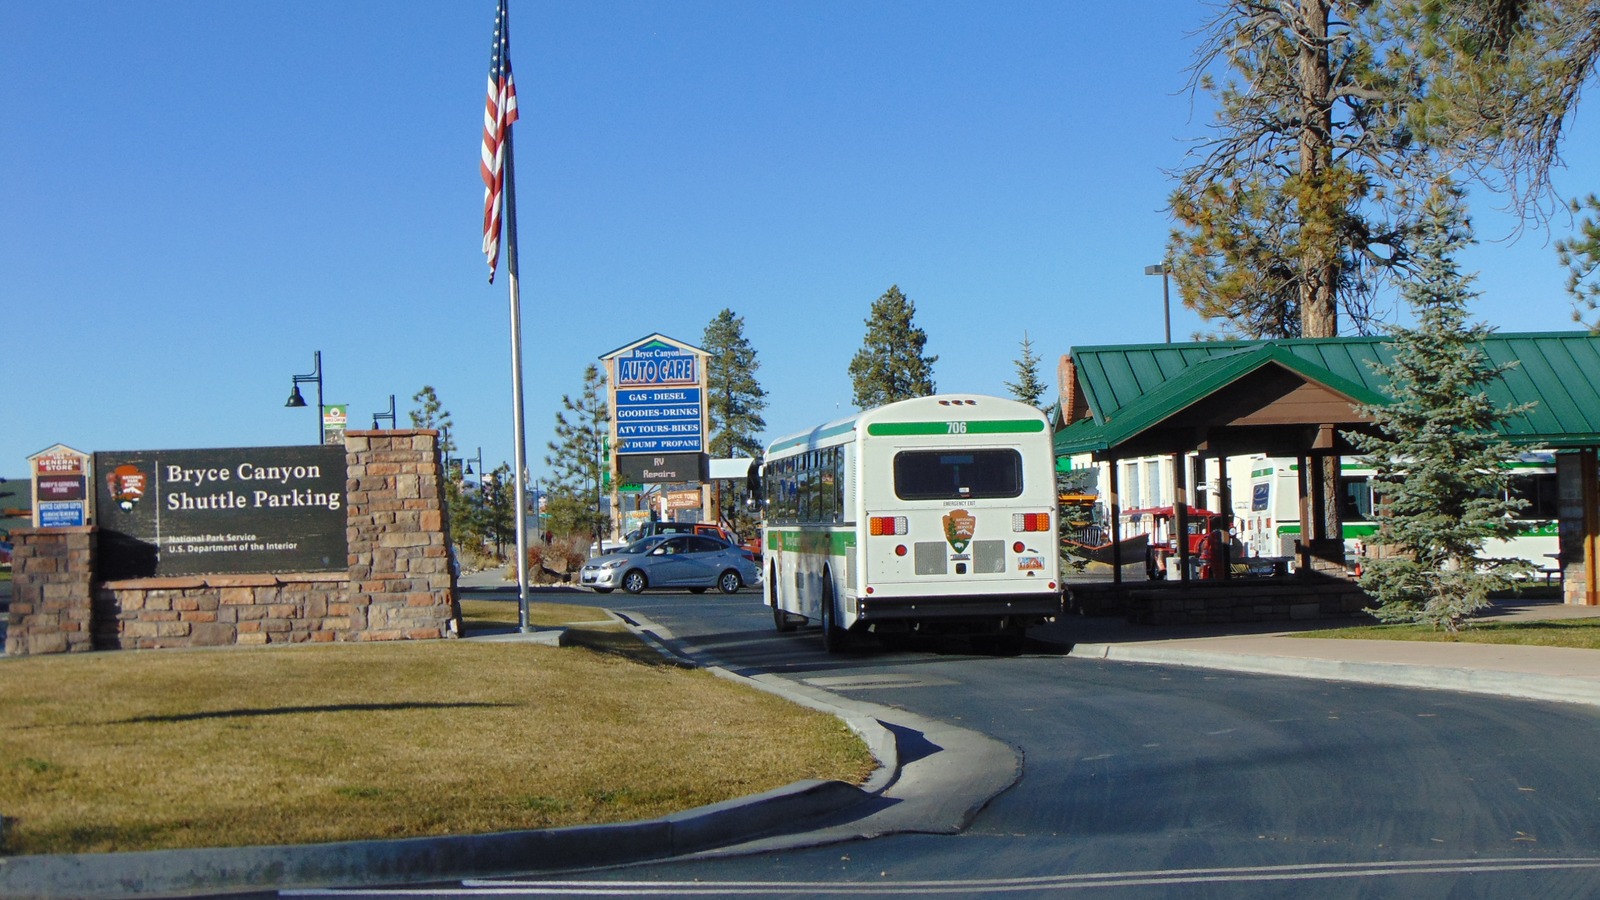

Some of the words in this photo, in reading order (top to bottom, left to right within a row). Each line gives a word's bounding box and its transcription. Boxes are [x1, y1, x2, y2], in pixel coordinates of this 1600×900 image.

[635, 350, 654, 360] Bryce
[654, 349, 680, 358] Canyon
[620, 360, 657, 382] AUTO
[658, 358, 692, 381] CARE
[618, 408, 698, 417] GOODIES-DRINKS
[619, 426, 637, 434] ATV
[638, 424, 699, 433] TOURS-BIKES
[946, 421, 967, 434] 706
[654, 457, 664, 466] RV
[167, 465, 230, 486] Bryce
[238, 463, 320, 486] Canyon
[643, 470, 676, 479] Repairs
[168, 490, 246, 510] Shuttle
[254, 489, 341, 510] Parking
[169, 534, 204, 542] National
[205, 534, 224, 542] Park
[226, 533, 256, 542] Service
[169, 545, 185, 553] U.S.
[188, 543, 236, 554] Department
[238, 543, 248, 552] of
[250, 543, 264, 551] the
[266, 542, 297, 550] Interior
